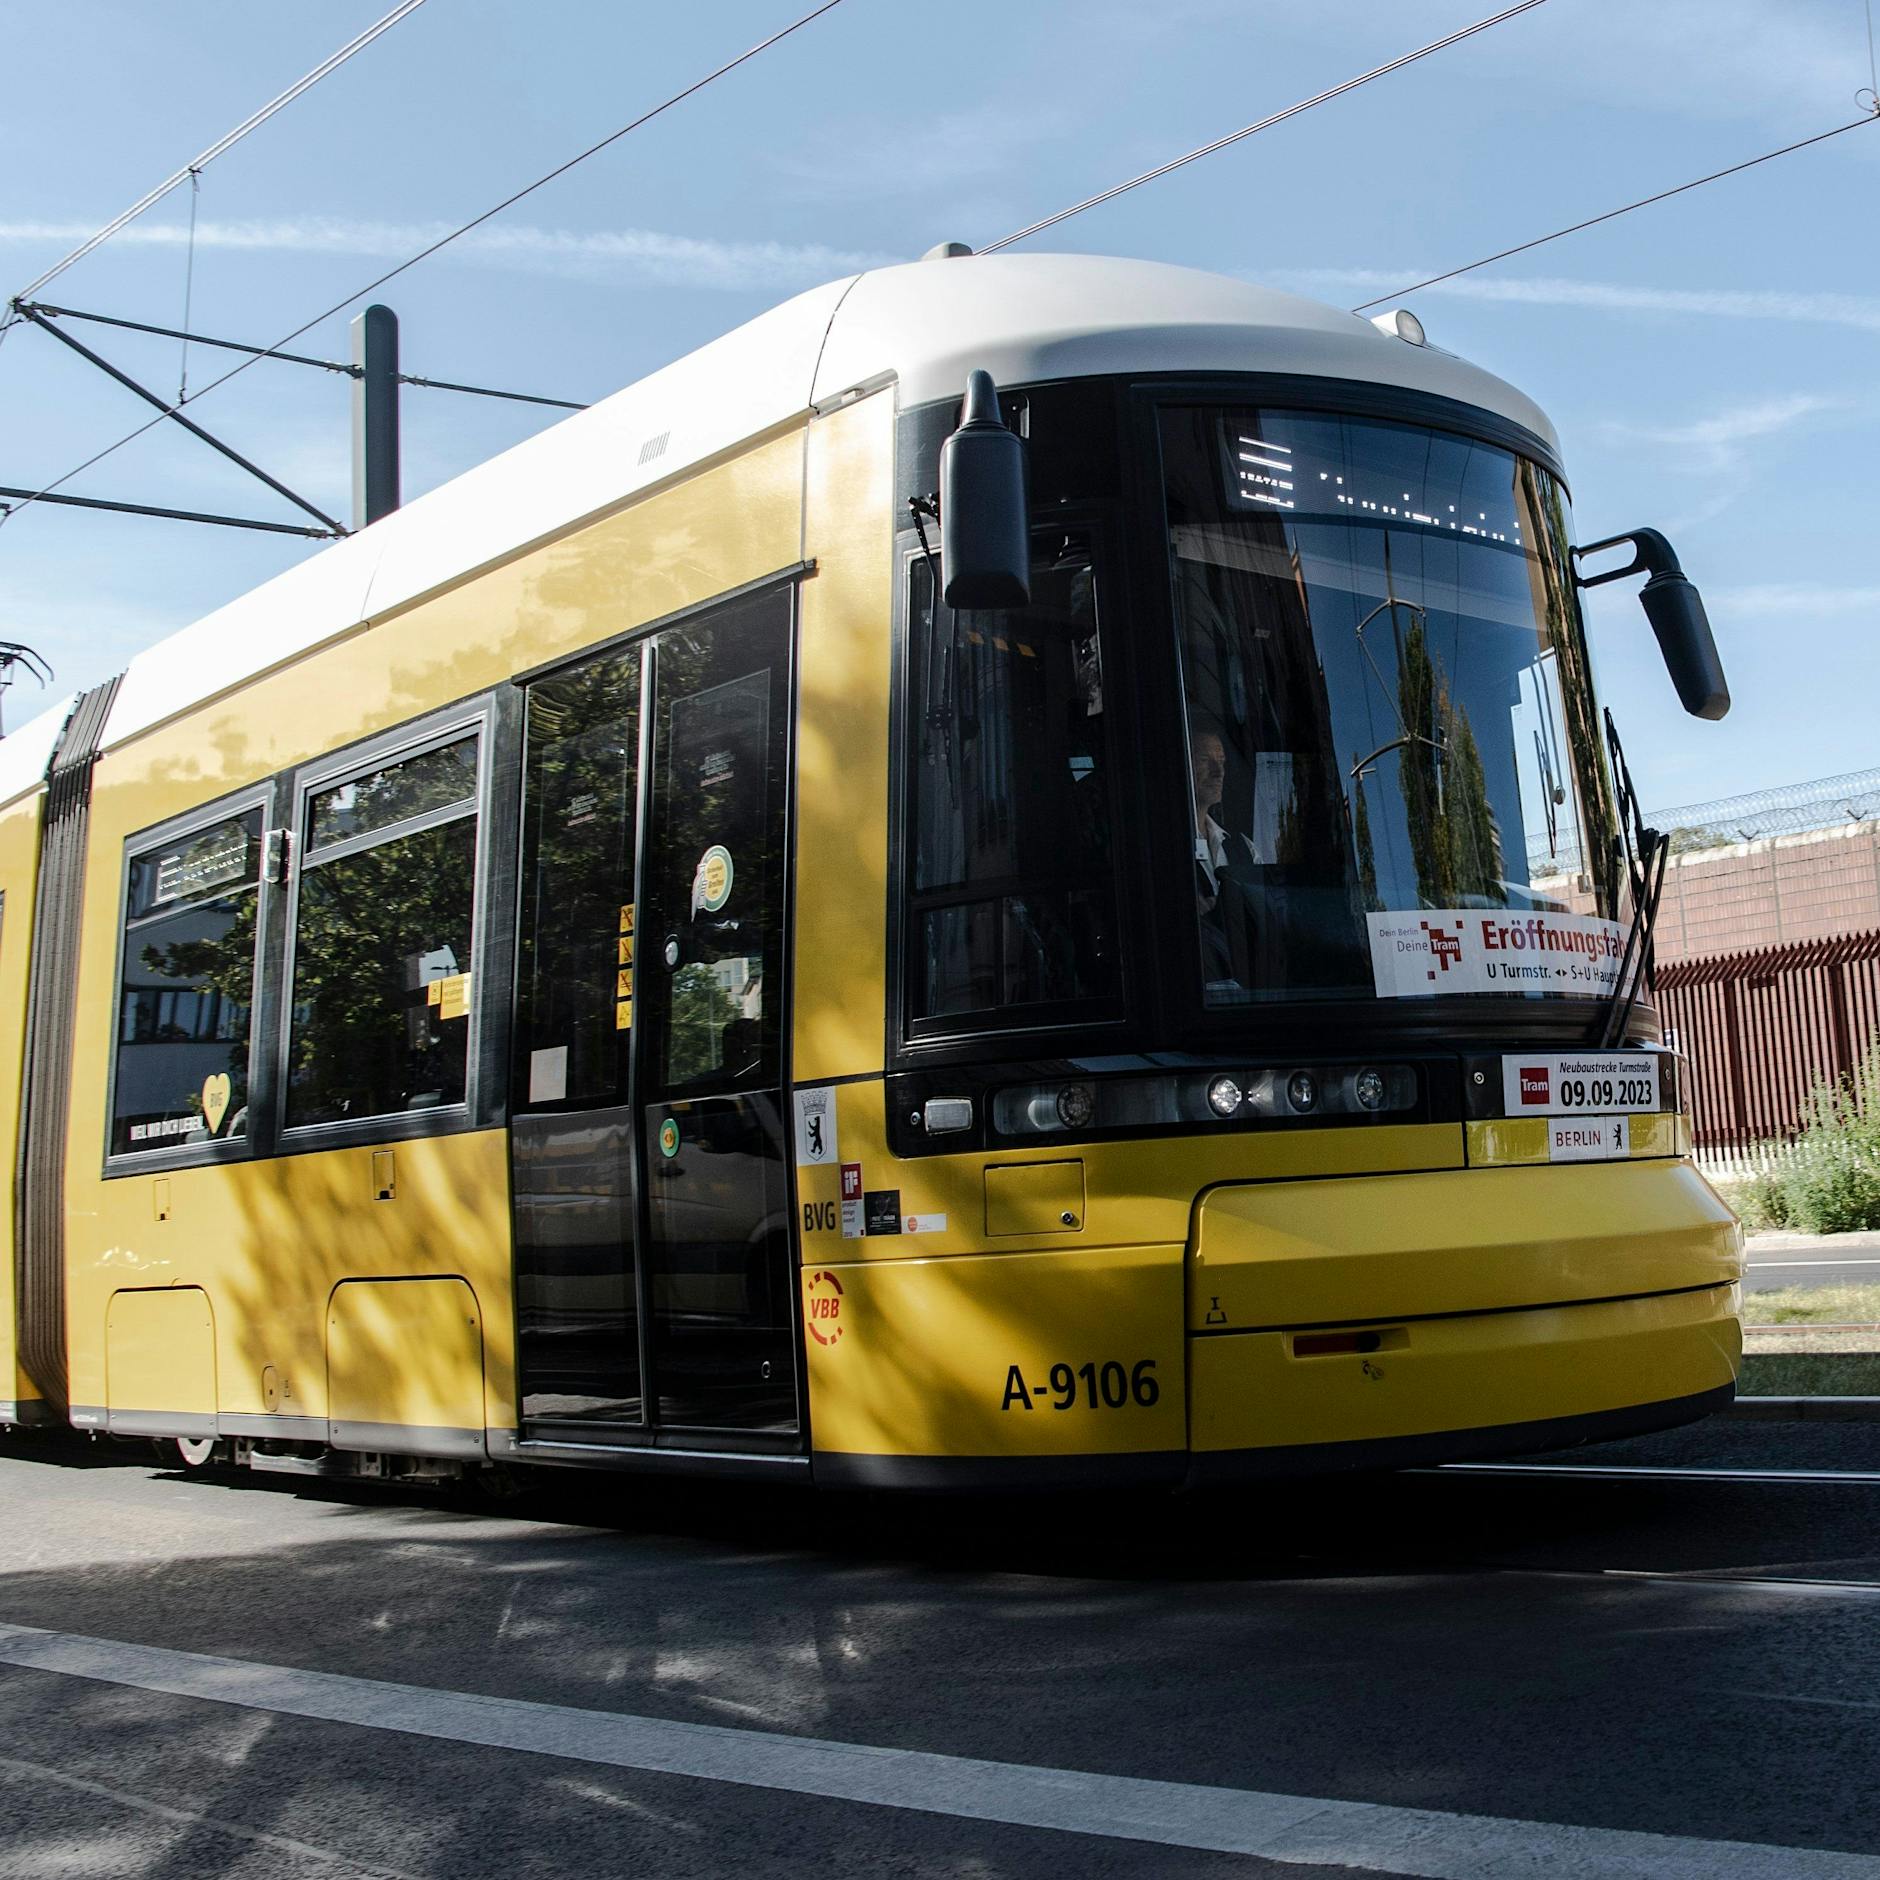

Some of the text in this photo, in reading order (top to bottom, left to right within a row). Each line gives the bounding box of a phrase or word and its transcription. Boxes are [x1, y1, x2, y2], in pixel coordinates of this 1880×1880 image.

[1379, 928, 1419, 937] Dein Berlin
[1481, 919, 1638, 962] Eröffnungsfah
[1397, 939, 1459, 952] Deine Tram
[1486, 963, 1497, 979] U
[1500, 963, 1552, 979] Turmstr.
[1571, 965, 1591, 981] S+U
[1559, 1061, 1651, 1073] Neubaustrecke Turmstraße
[1521, 1078, 1549, 1092] Tram
[1560, 1080, 1652, 1107] 09.09.2023
[1555, 1130, 1601, 1147] BERLIN
[803, 1201, 836, 1232] BVG
[810, 1298, 840, 1319] VBB
[1001, 1359, 1160, 1411] A-9106
